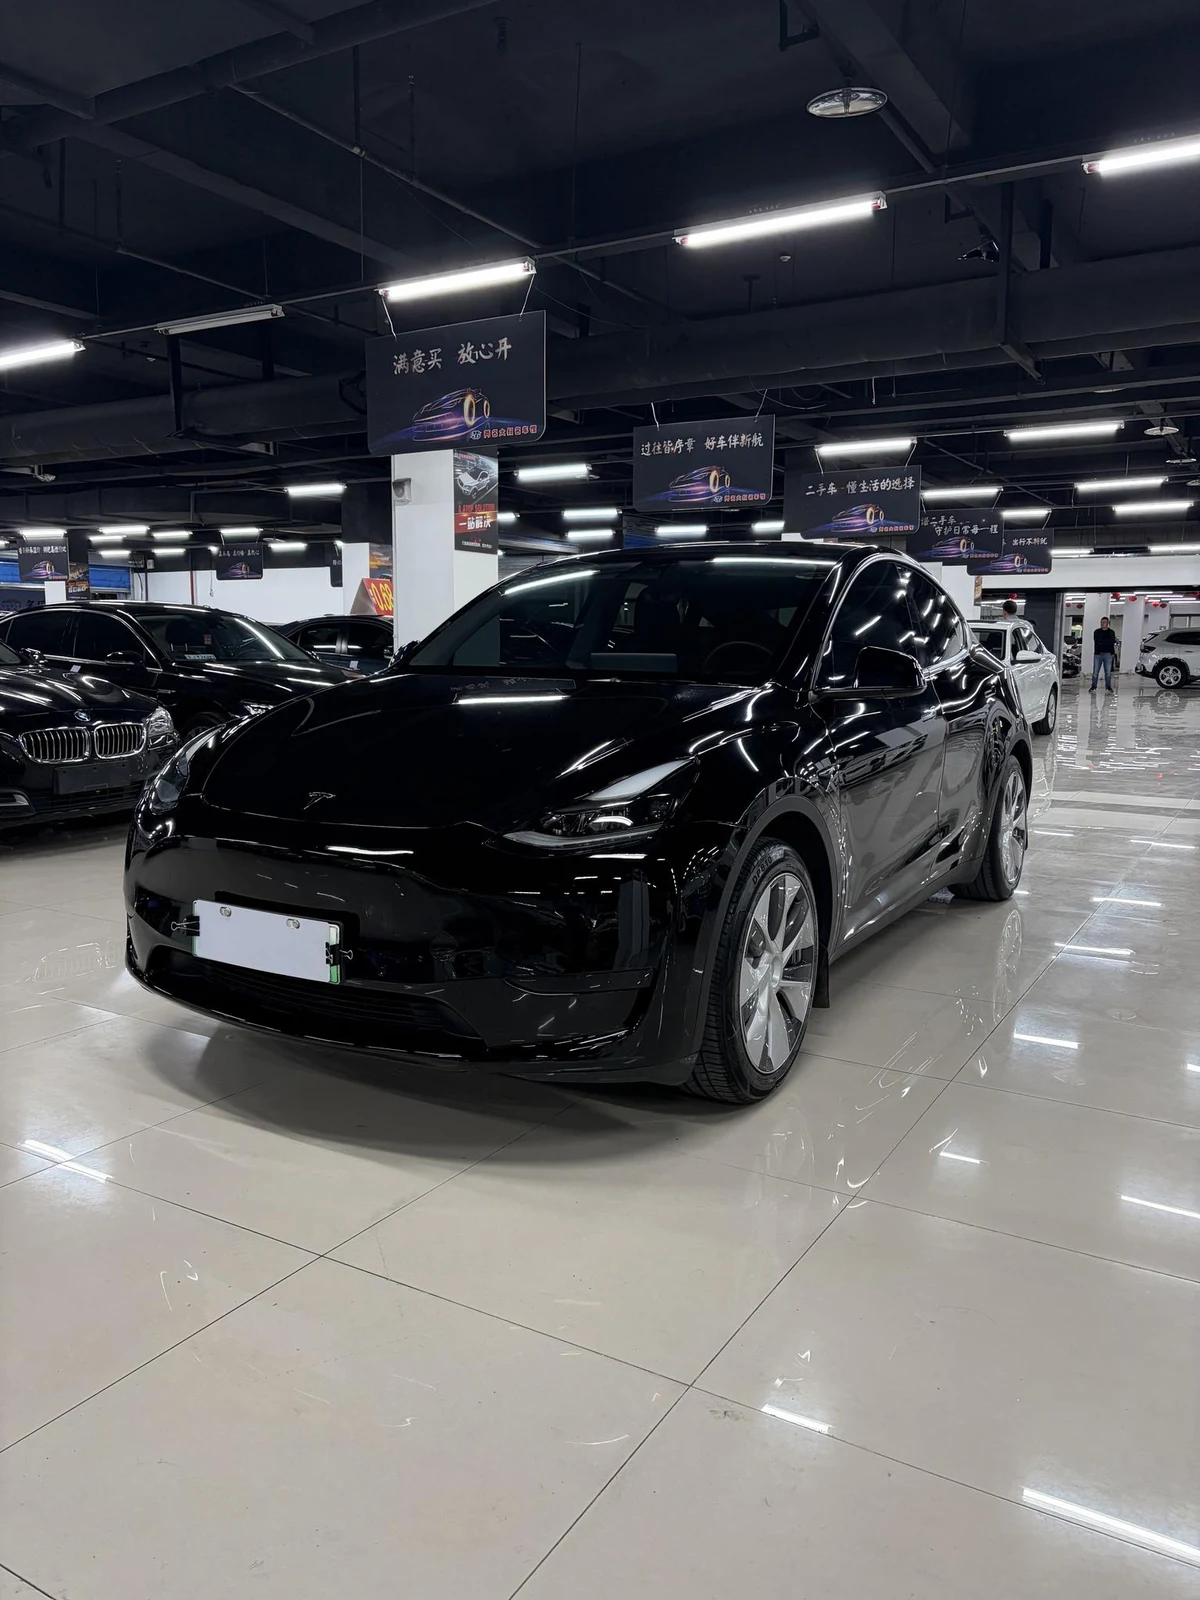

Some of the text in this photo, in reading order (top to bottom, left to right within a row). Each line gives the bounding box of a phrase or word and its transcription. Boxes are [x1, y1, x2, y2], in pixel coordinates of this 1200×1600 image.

[393, 337, 512, 375] 满意买 放心开
[641, 432, 764, 456] 过往皆序章 好车伴新航
[805, 476, 916, 497] 二手车 懂生活的选择
[458, 515, 492, 530] 一站解决
[934, 524, 999, 537] 守护日常每一程
